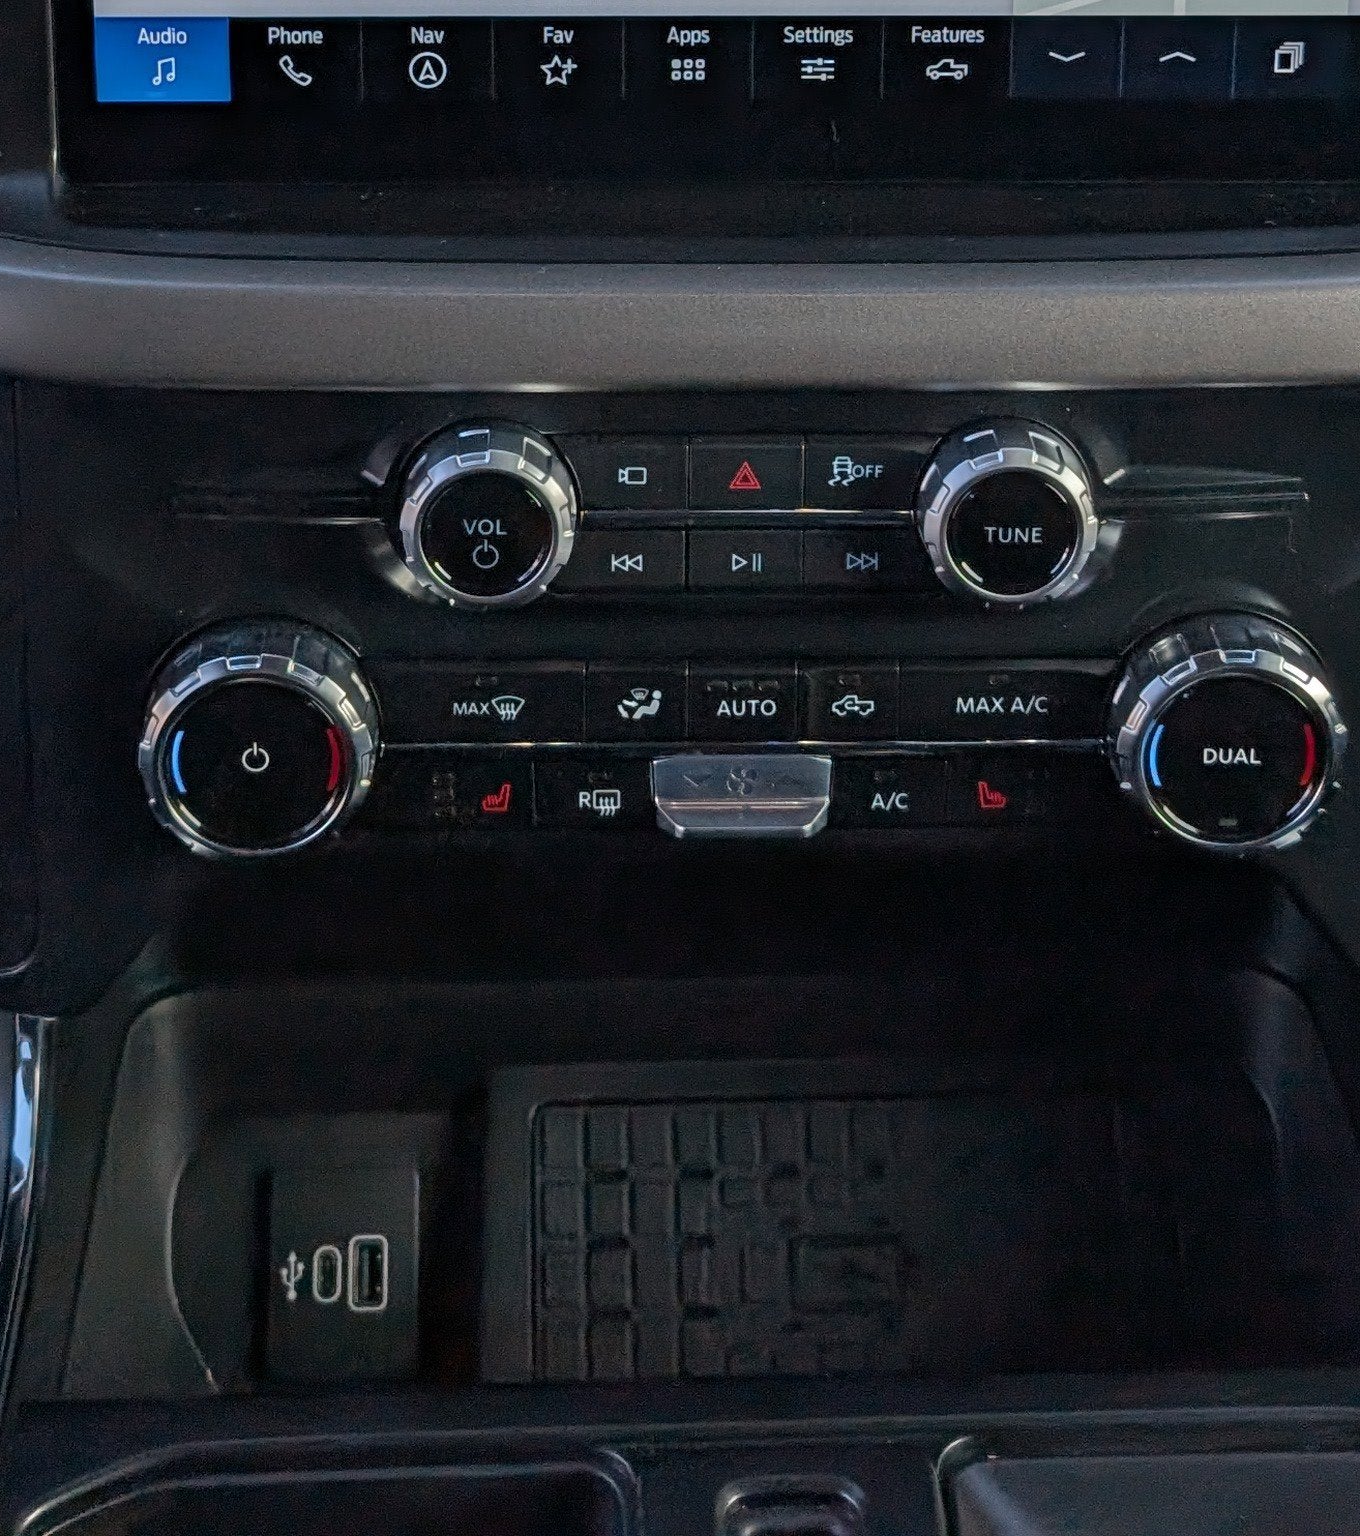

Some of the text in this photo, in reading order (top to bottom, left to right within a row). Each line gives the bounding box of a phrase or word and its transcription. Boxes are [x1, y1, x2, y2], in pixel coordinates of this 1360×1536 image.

[138, 27, 187, 44] Audio
[267, 27, 323, 44] Phone
[410, 27, 444, 44] Nav
[543, 27, 574, 44] Fav
[667, 26, 710, 48] Apps
[783, 25, 854, 48] Settings
[911, 25, 984, 45] Features
[852, 464, 883, 479] OFF
[462, 519, 507, 536] VOL
[984, 526, 1042, 544] TUNE
[452, 702, 490, 716] MAX
[716, 698, 777, 716] AUTO
[956, 696, 1049, 715] MAX A/C
[1202, 747, 1262, 765] DUAL
[578, 792, 591, 808] R
[871, 792, 908, 812] A/C
